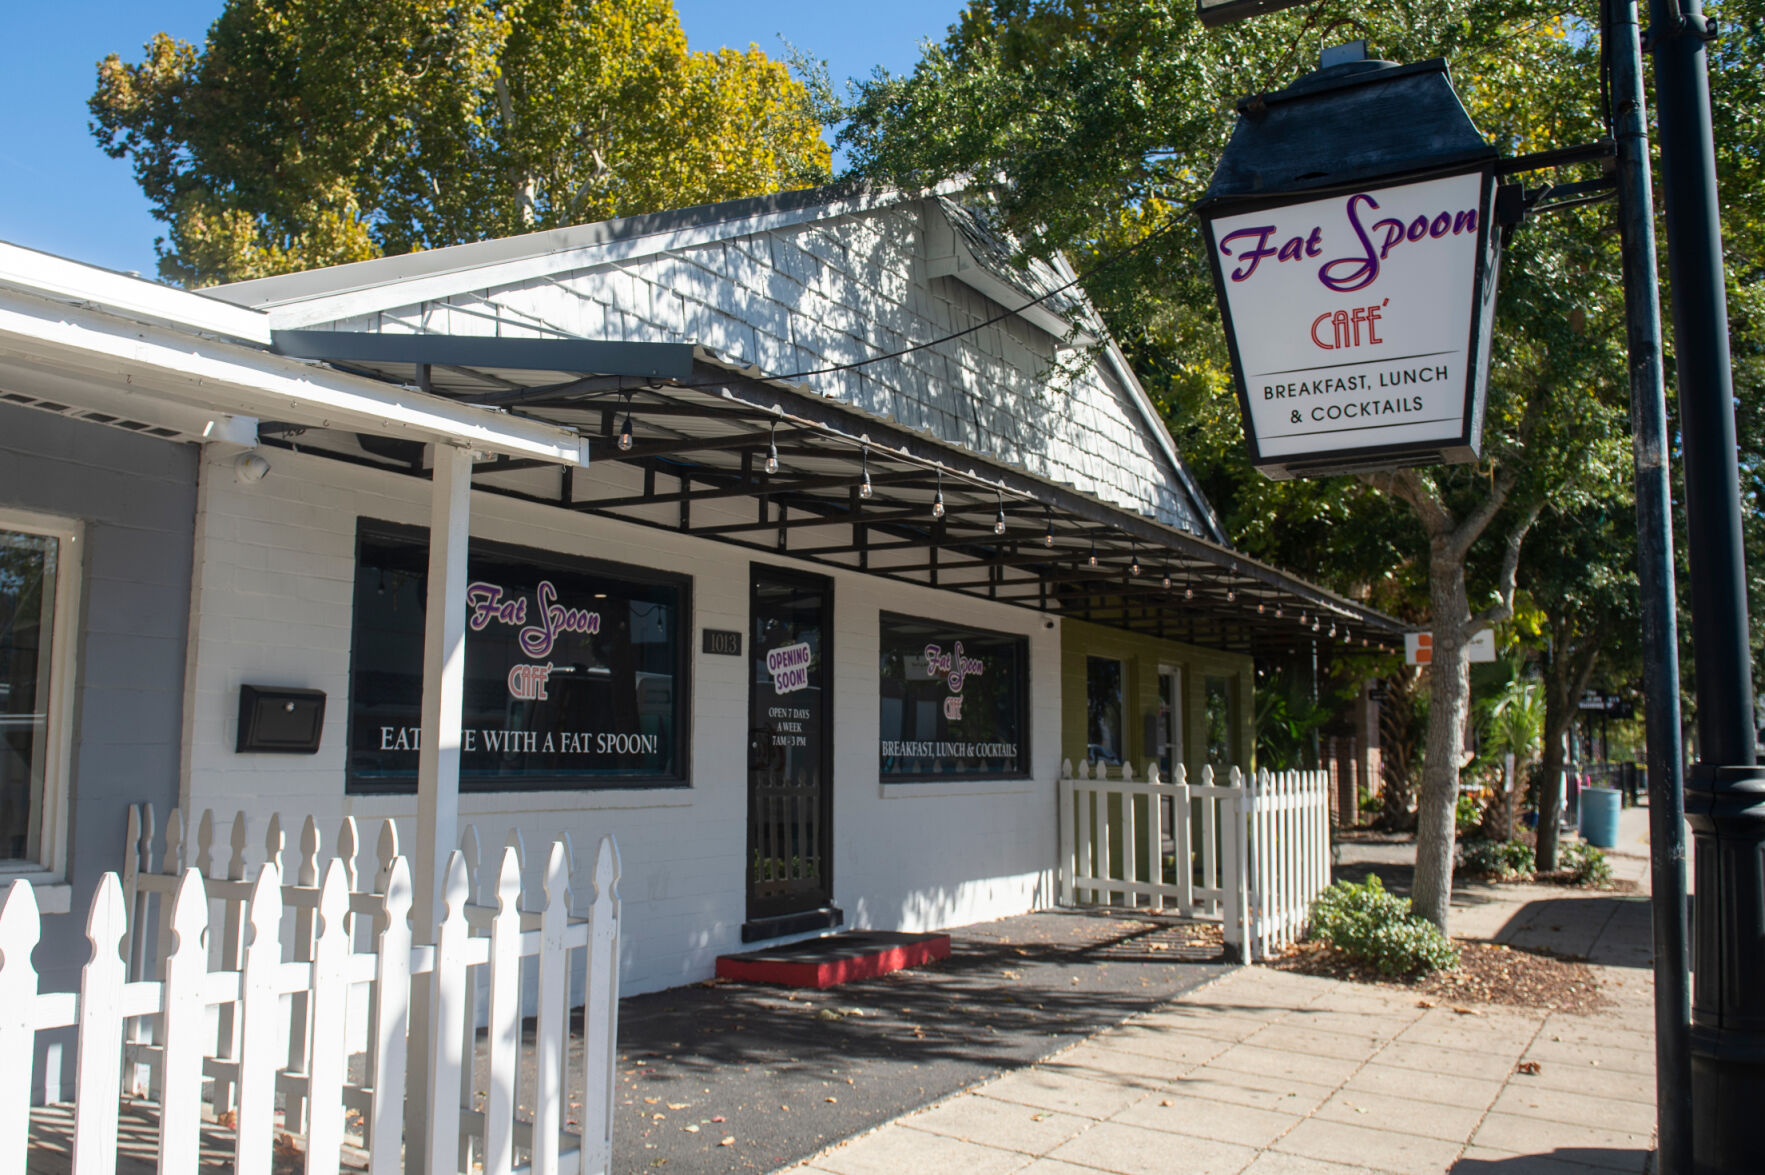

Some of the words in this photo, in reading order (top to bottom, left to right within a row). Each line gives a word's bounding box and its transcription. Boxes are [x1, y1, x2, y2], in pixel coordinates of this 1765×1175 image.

[1219, 225, 1323, 282] Fat
[1318, 193, 1478, 293] Spoon
[1263, 374, 1371, 400] BREAKFAST,
[1379, 365, 1449, 388] LUNCH
[1290, 410, 1303, 424] &
[1311, 396, 1424, 423] COCKTAILS
[467, 581, 527, 632] Fat
[518, 580, 602, 660] Spoon
[711, 633, 738, 653] 1013
[769, 646, 809, 671] OPENING
[925, 644, 951, 676] Fat
[947, 640, 983, 693] Spoon
[776, 668, 807, 690] SOON!
[768, 707, 787, 718] OPEN
[788, 708, 792, 717] 7
[793, 709, 810, 719] DAYS
[379, 726, 422, 751] EAT
[783, 722, 802, 732] WEEK
[481, 729, 538, 753] WITH
[541, 731, 556, 753] A
[560, 732, 593, 753] FAT
[596, 732, 658, 755] SPOON!
[882, 741, 934, 758] BREAKFAST,
[936, 742, 965, 757] LUNCH
[967, 743, 975, 757] &
[976, 742, 1017, 757] COCKTAILS
